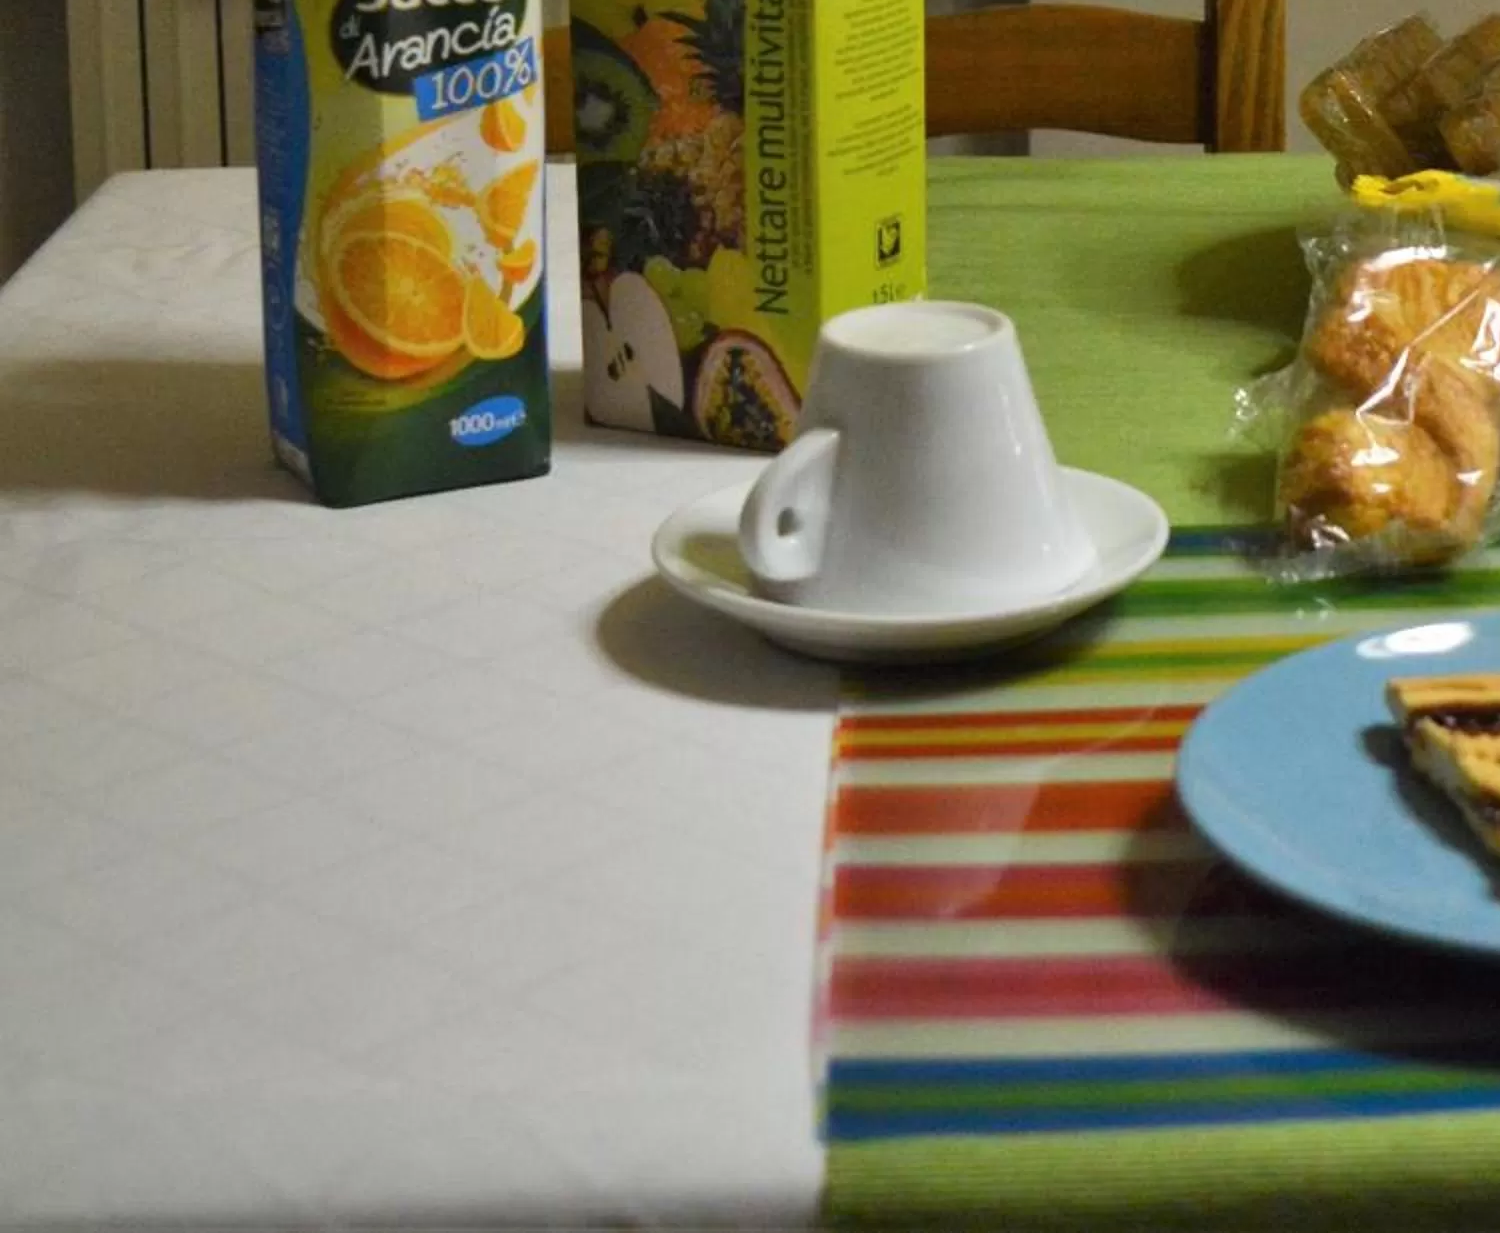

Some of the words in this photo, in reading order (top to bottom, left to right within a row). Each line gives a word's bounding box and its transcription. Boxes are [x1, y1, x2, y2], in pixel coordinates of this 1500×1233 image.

[430, 39, 532, 111] 100%
[753, 168, 789, 316] Nettare
[448, 410, 495, 437] 1000
